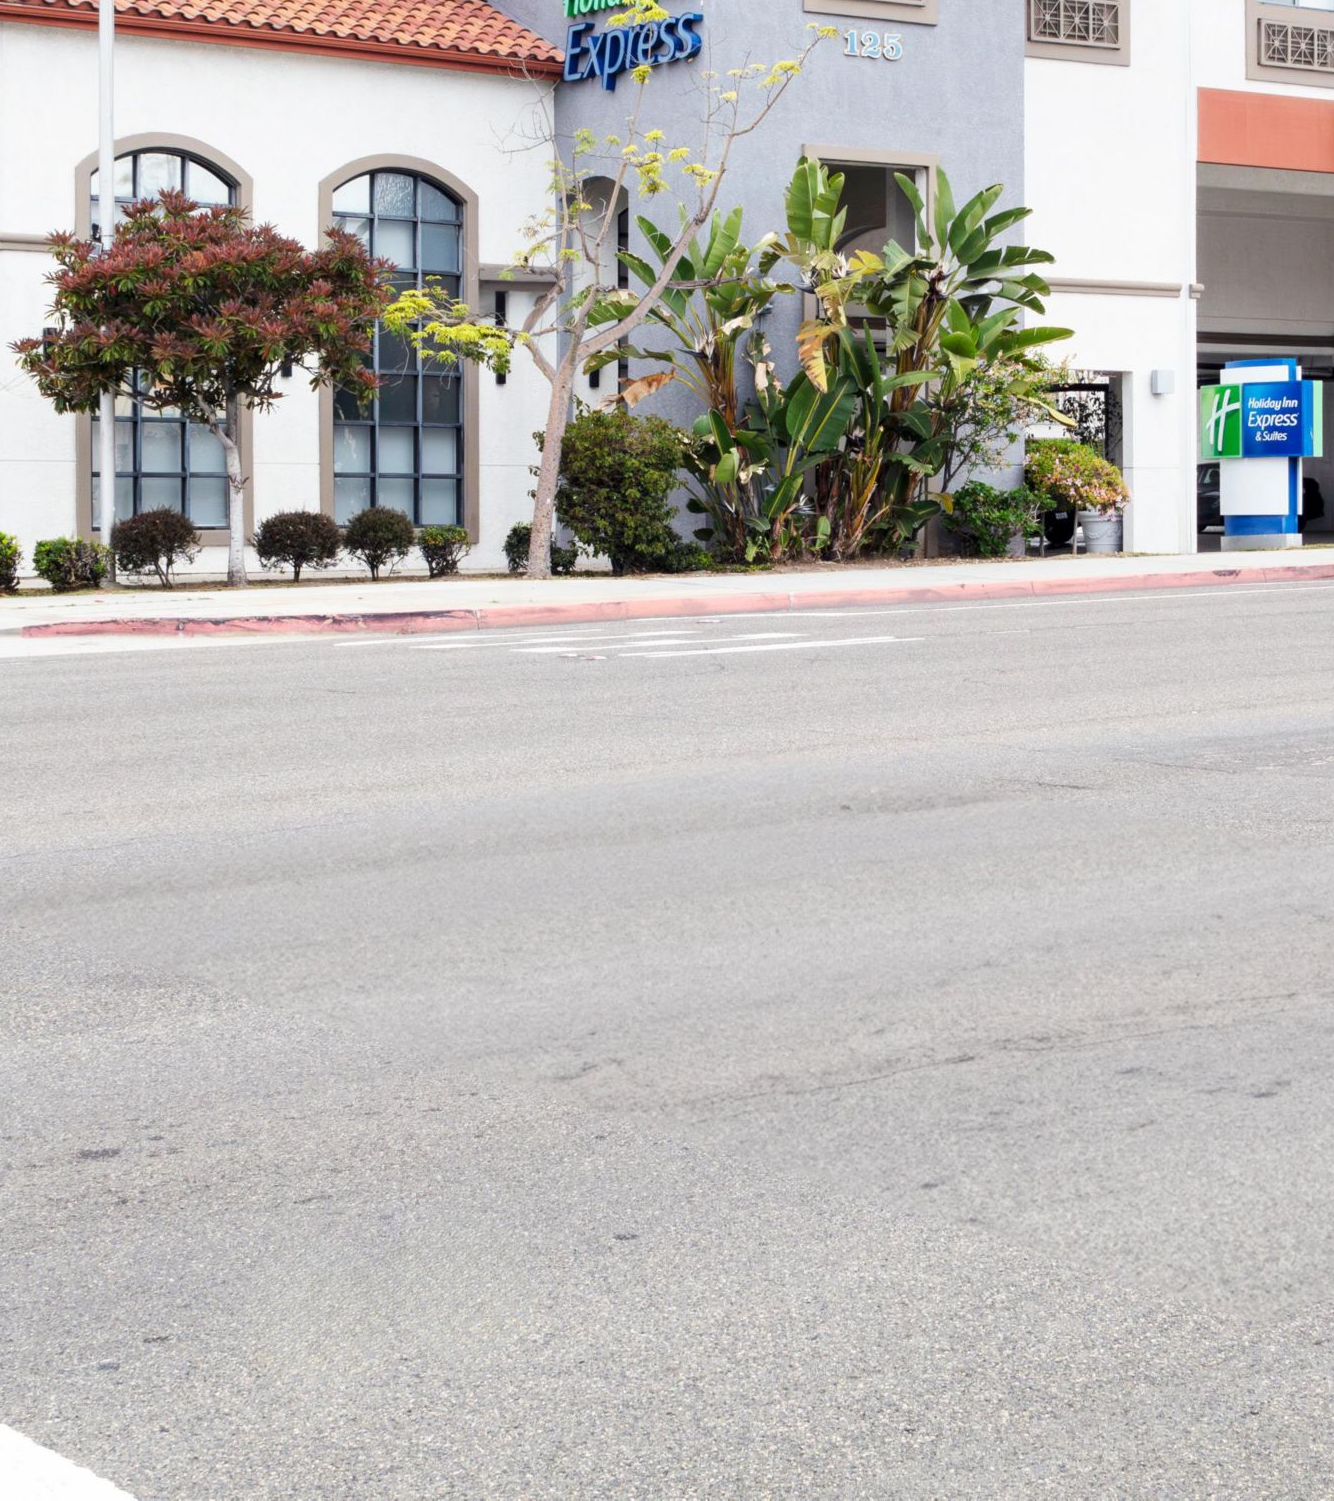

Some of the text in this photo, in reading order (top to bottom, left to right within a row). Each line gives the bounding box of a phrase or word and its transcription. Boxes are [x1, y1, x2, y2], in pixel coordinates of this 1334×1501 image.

[563, 12, 704, 92] Express
[844, 29, 903, 61] 125
[1248, 396, 1298, 411] Holiday Inn
[1248, 411, 1298, 430] Express
[1255, 431, 1288, 441] & Suites
